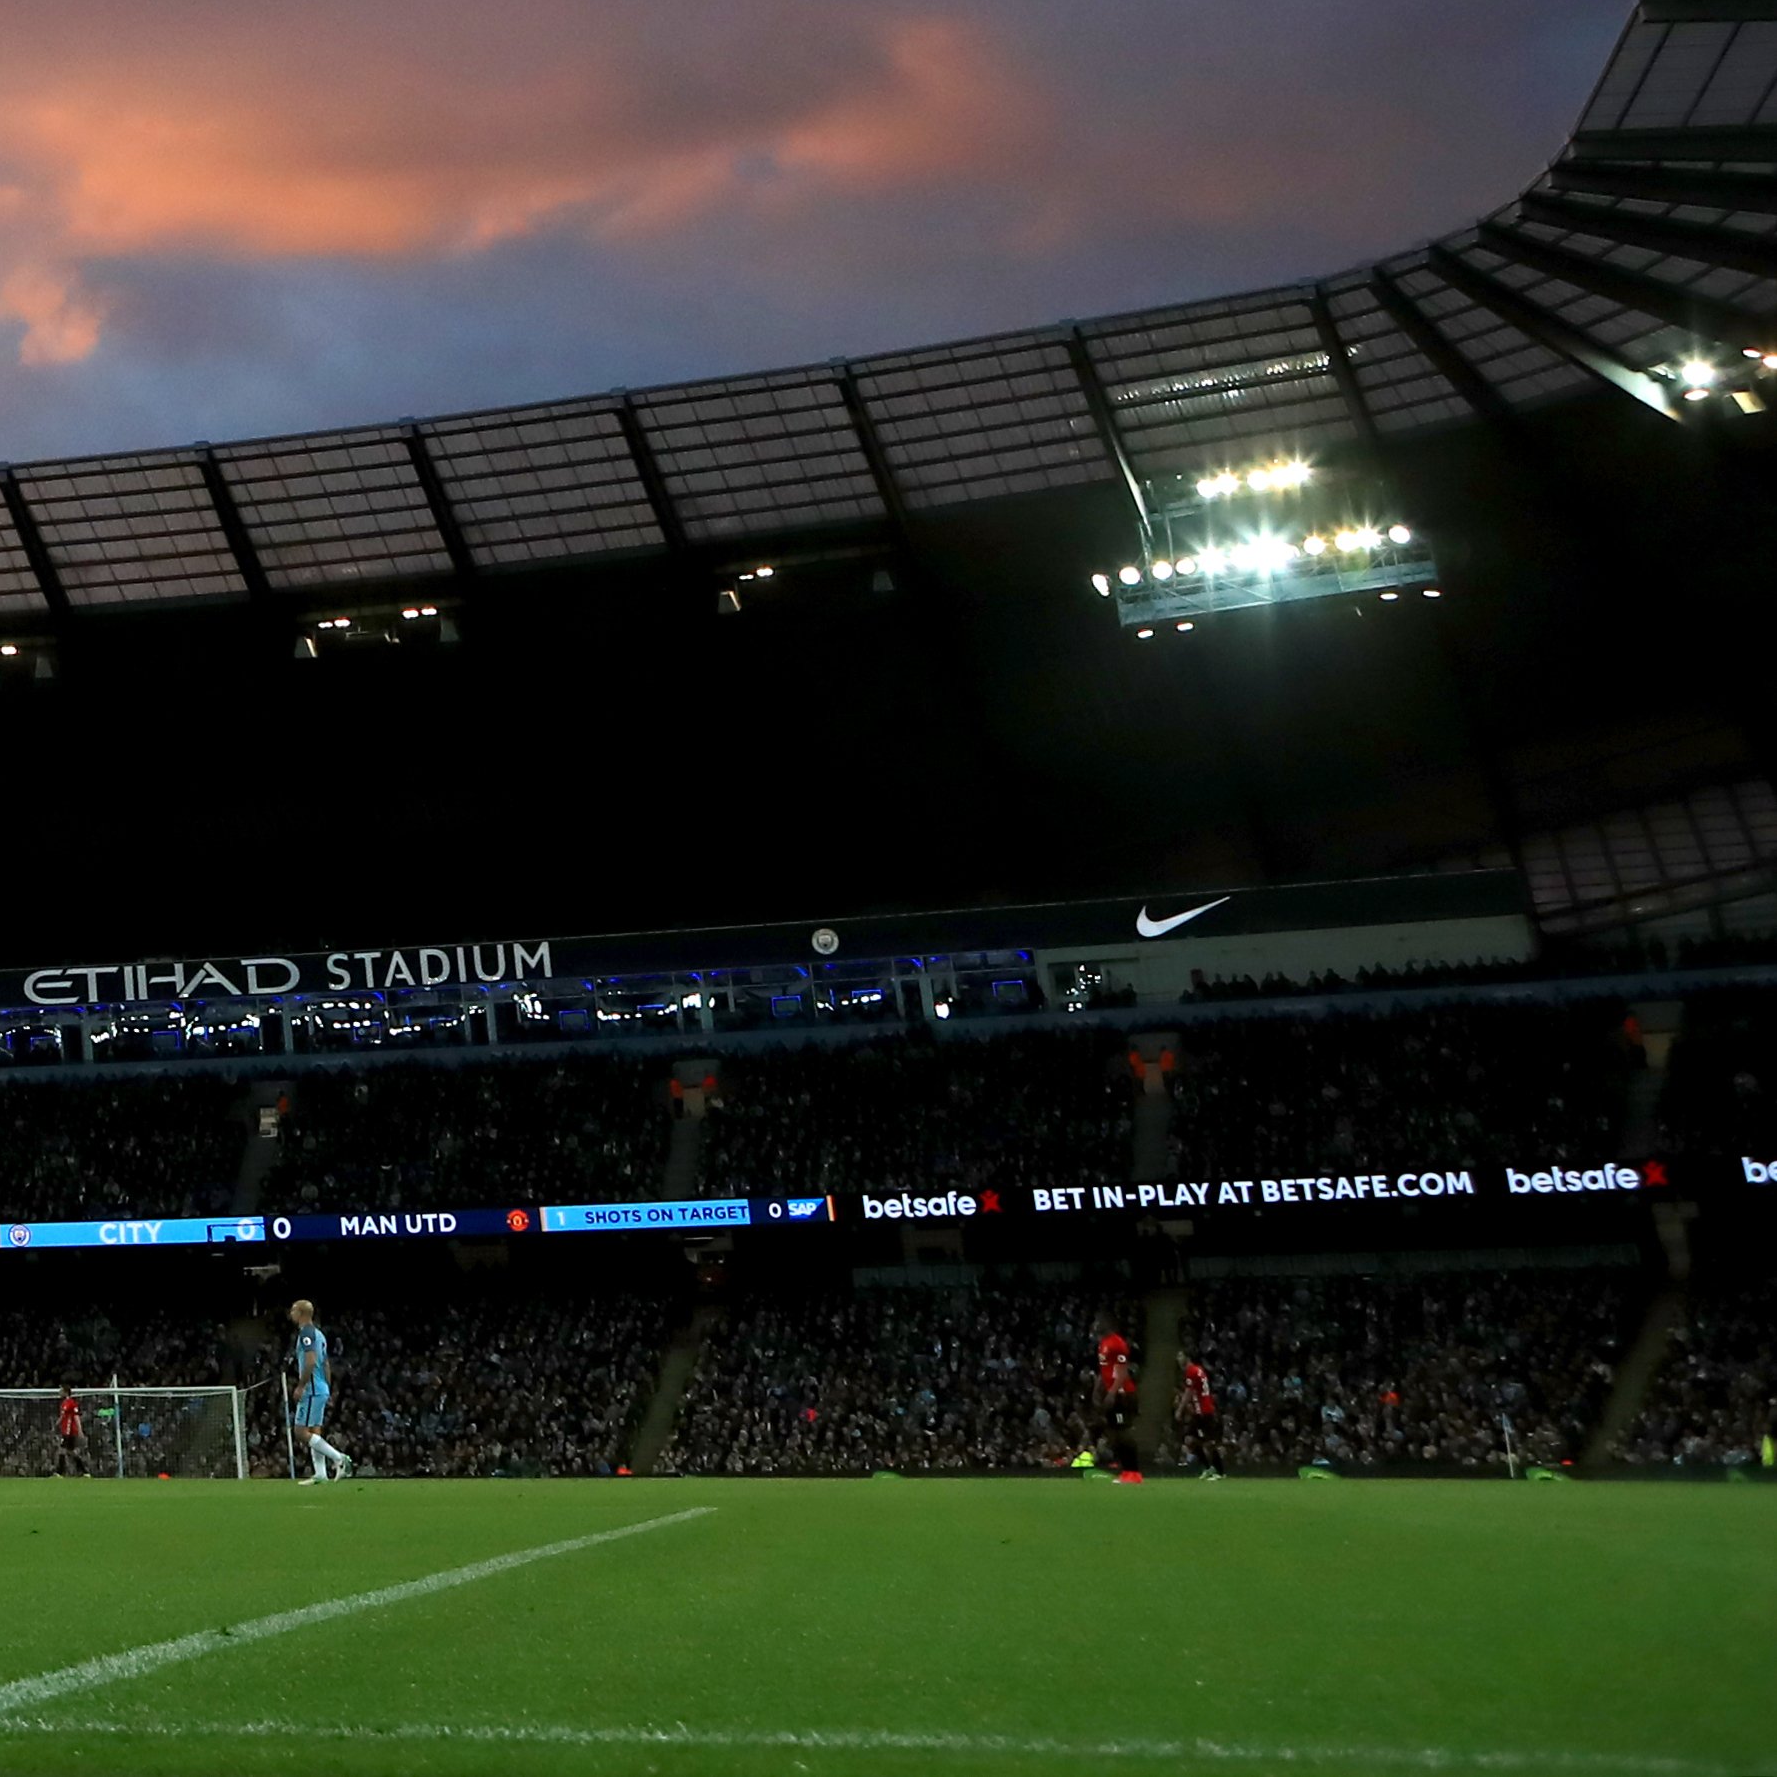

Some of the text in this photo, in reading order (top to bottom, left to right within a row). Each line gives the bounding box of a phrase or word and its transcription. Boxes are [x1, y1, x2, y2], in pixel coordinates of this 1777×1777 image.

[23, 941, 552, 1004] ETIHAD STADIUM
[1033, 1171, 1474, 1211] BET IN-PLAY AT BETSAFE.COM
[1506, 1163, 1640, 1194] betsafe
[557, 1202, 782, 1225] 1 SHOTS ON TARGET 0
[788, 1202, 817, 1216] SAP
[862, 1190, 977, 1219] betsafe
[99, 1218, 256, 1244] CITY 0
[273, 1213, 457, 1240] 0 MAN UTD
